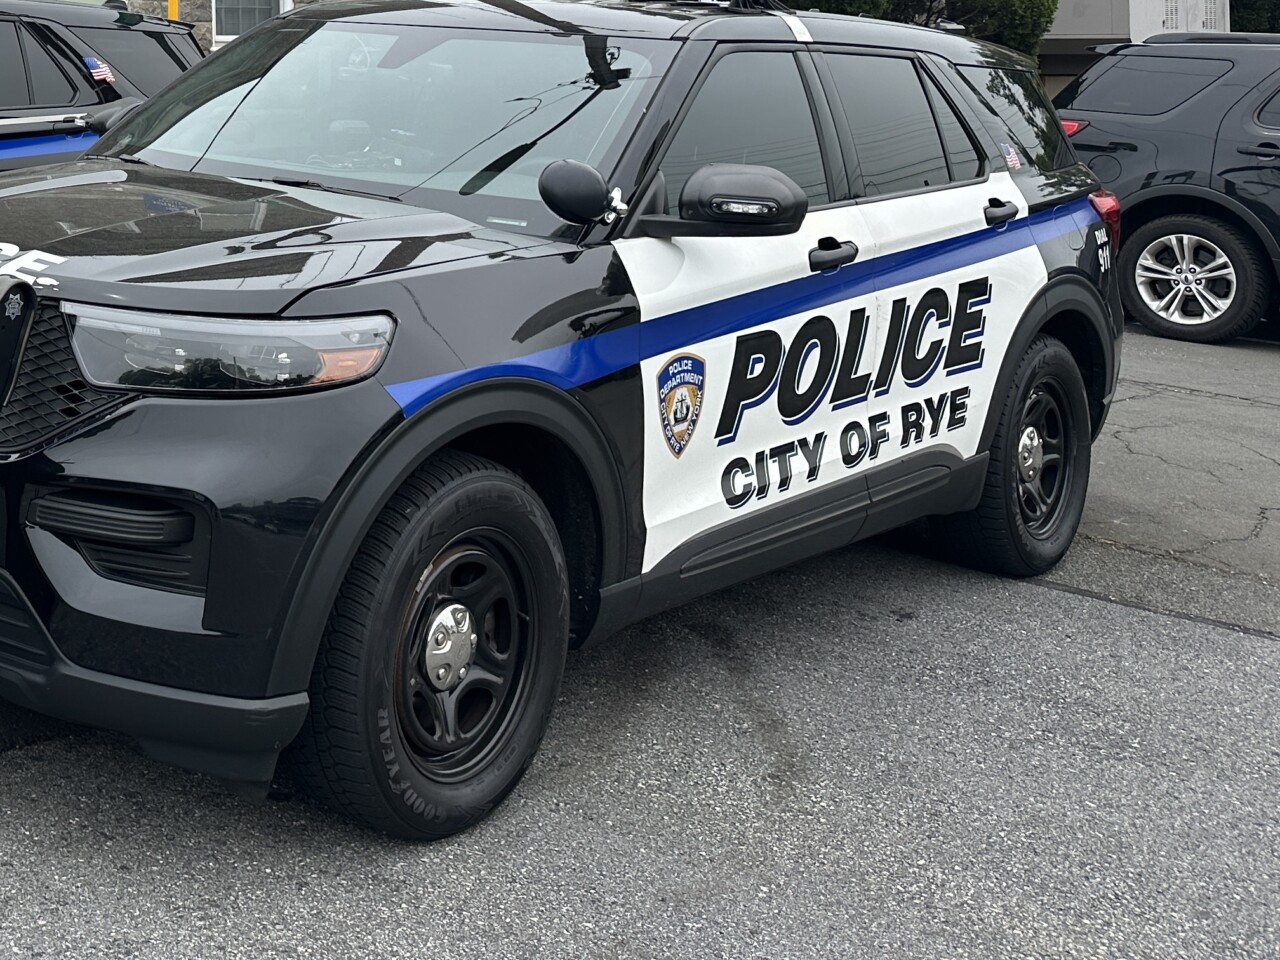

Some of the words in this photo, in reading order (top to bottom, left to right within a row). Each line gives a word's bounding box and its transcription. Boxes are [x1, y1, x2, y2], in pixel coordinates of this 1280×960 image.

[1094, 228, 1108, 245] DIAL
[1098, 245, 1110, 272] 911
[668, 360, 692, 376] POLICE
[714, 276, 992, 447] POLICE
[660, 373, 703, 399] DEPARTMENT
[660, 402, 668, 425] CITY
[681, 422, 694, 448] NEW
[692, 390, 702, 420] YORK
[666, 426, 673, 438] OF
[669, 437, 680, 452] RYE
[721, 432, 828, 509] CITY
[840, 412, 890, 468] OF
[901, 386, 970, 448] RYE
